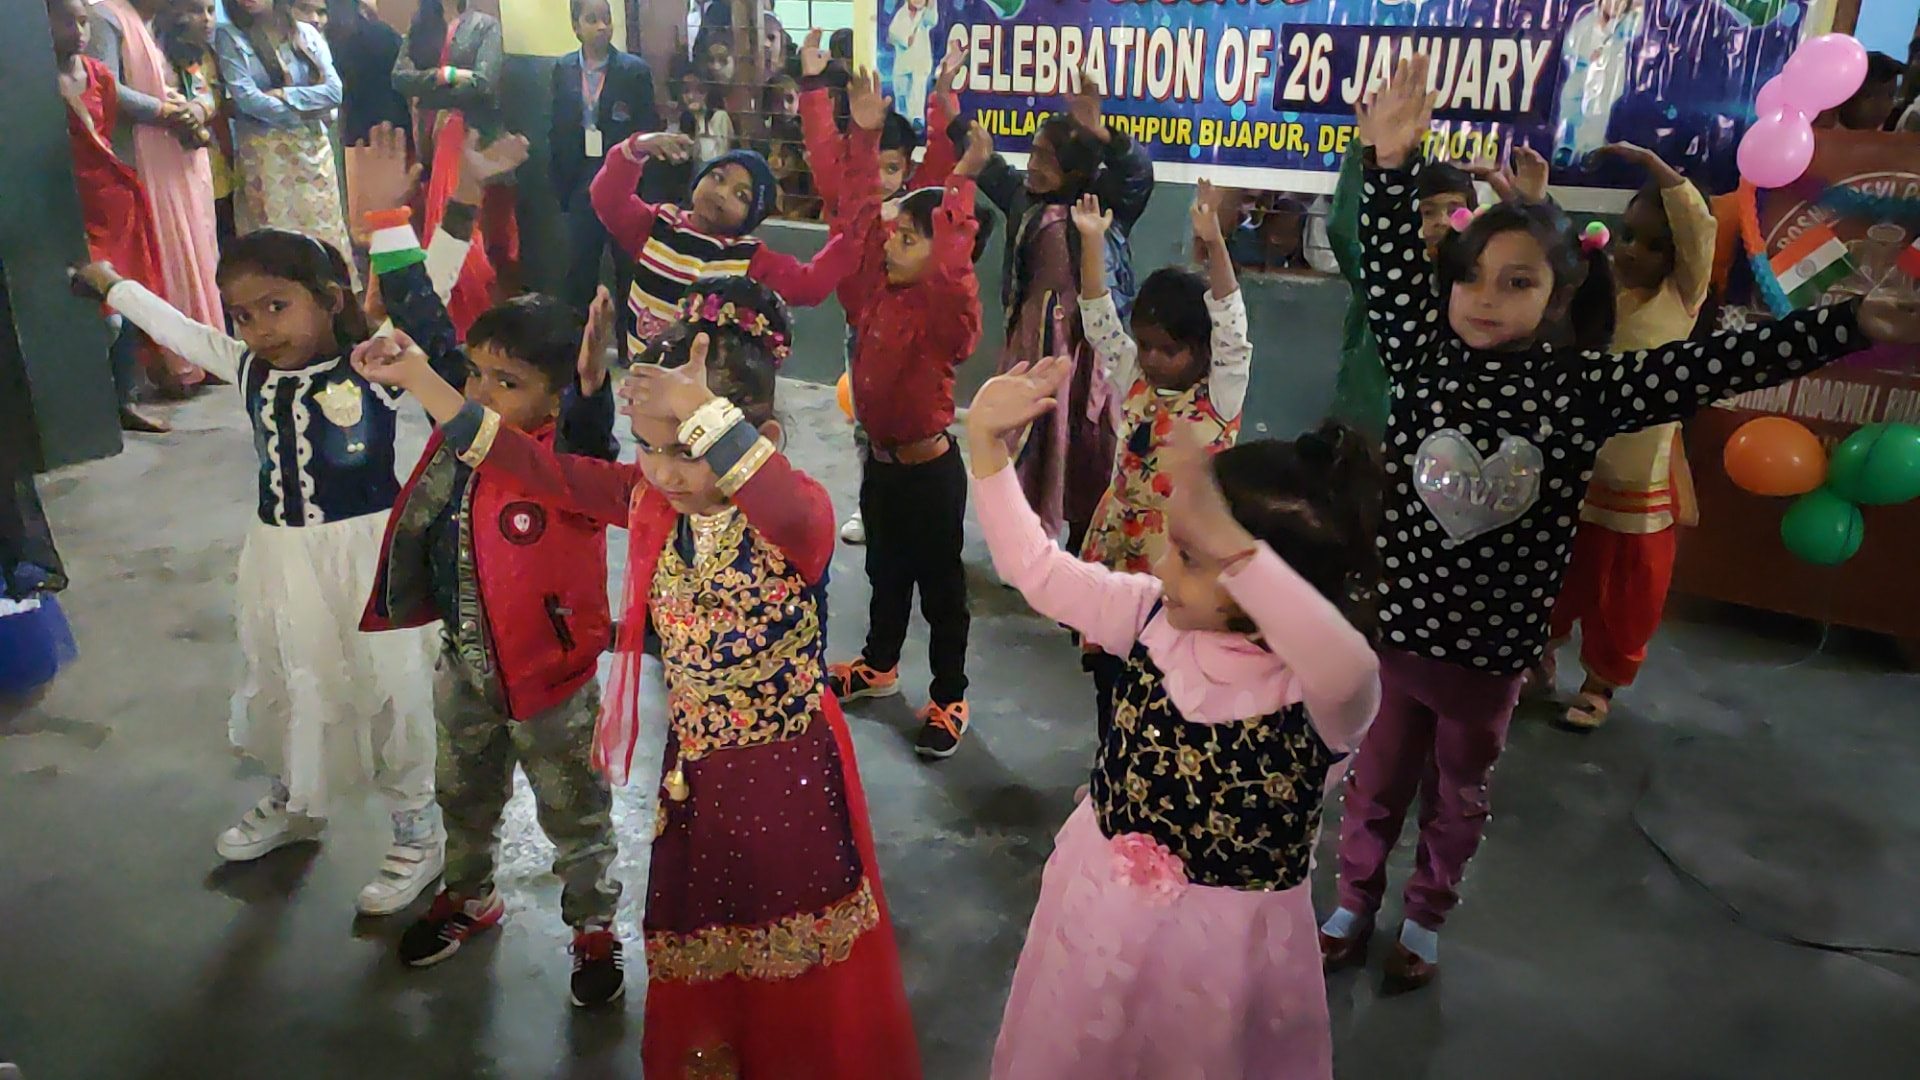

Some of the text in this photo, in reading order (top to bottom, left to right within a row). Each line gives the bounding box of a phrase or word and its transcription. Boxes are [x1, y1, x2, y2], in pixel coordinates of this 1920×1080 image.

[948, 23, 1206, 101] CELEBRATION
[1214, 28, 1273, 104] OF
[1282, 32, 1333, 104] 26
[1098, 114, 1193, 146] UDHPUR
